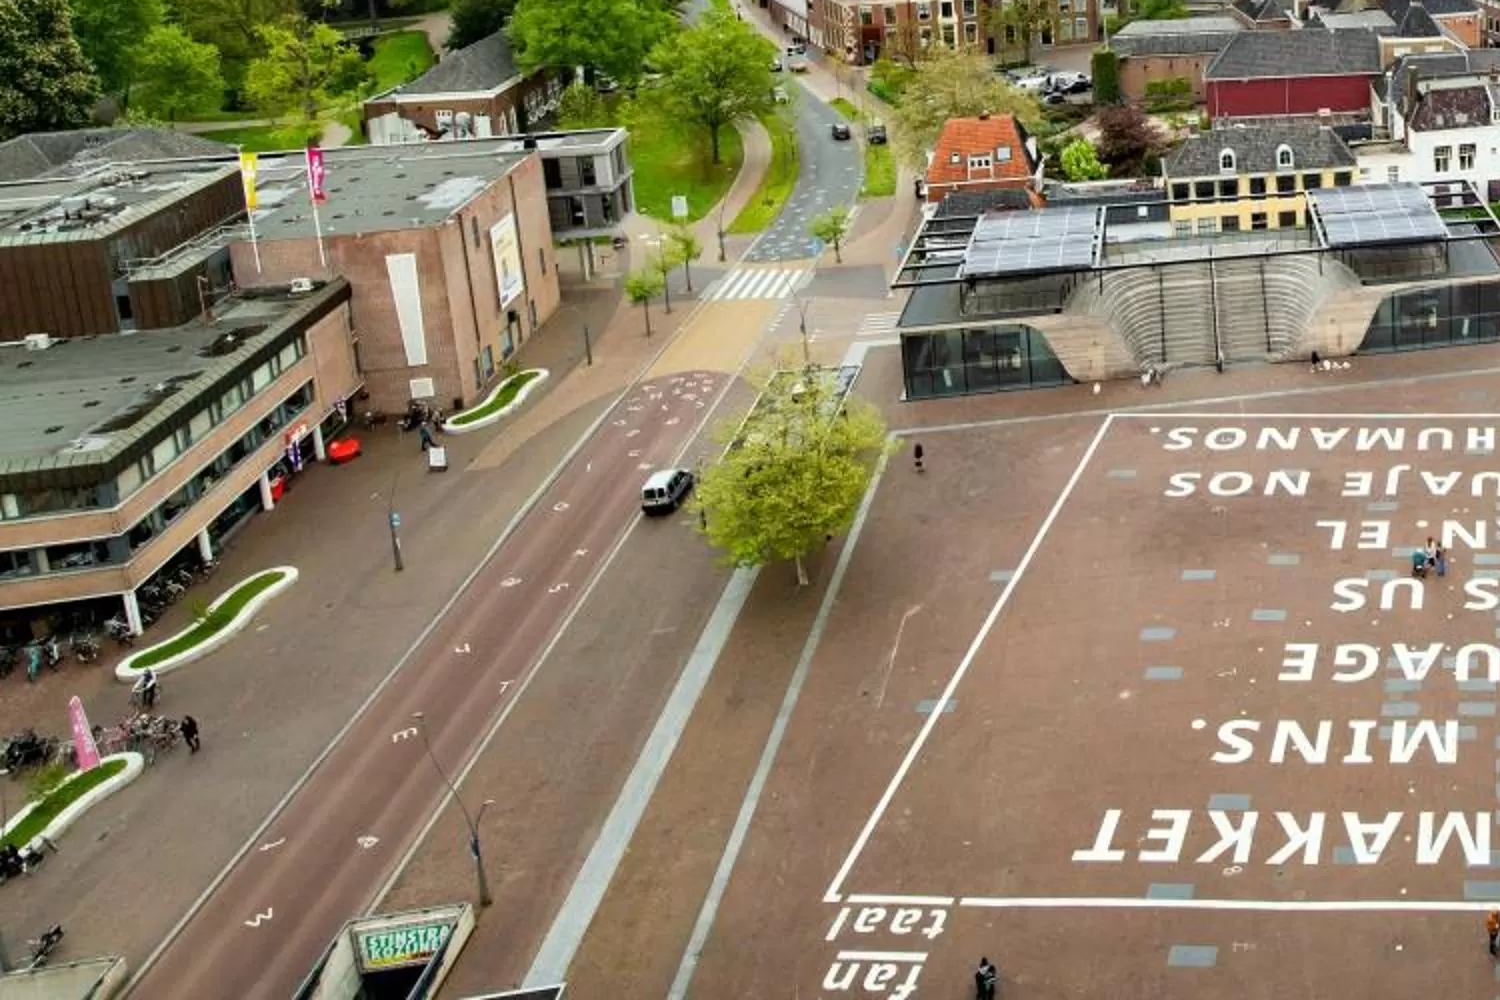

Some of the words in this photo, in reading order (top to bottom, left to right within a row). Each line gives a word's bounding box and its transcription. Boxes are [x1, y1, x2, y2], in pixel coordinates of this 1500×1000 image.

[1150, 426, 1496, 452] HUMANOS.
[1163, 470, 1310, 498] NOS
[1315, 519, 1392, 550] EL
[1329, 577, 1426, 613] US
[1190, 718, 1460, 765] MINS.
[1070, 808, 1492, 867] MAKKET
[824, 906, 948, 942] taal
[822, 962, 923, 1000] fan
